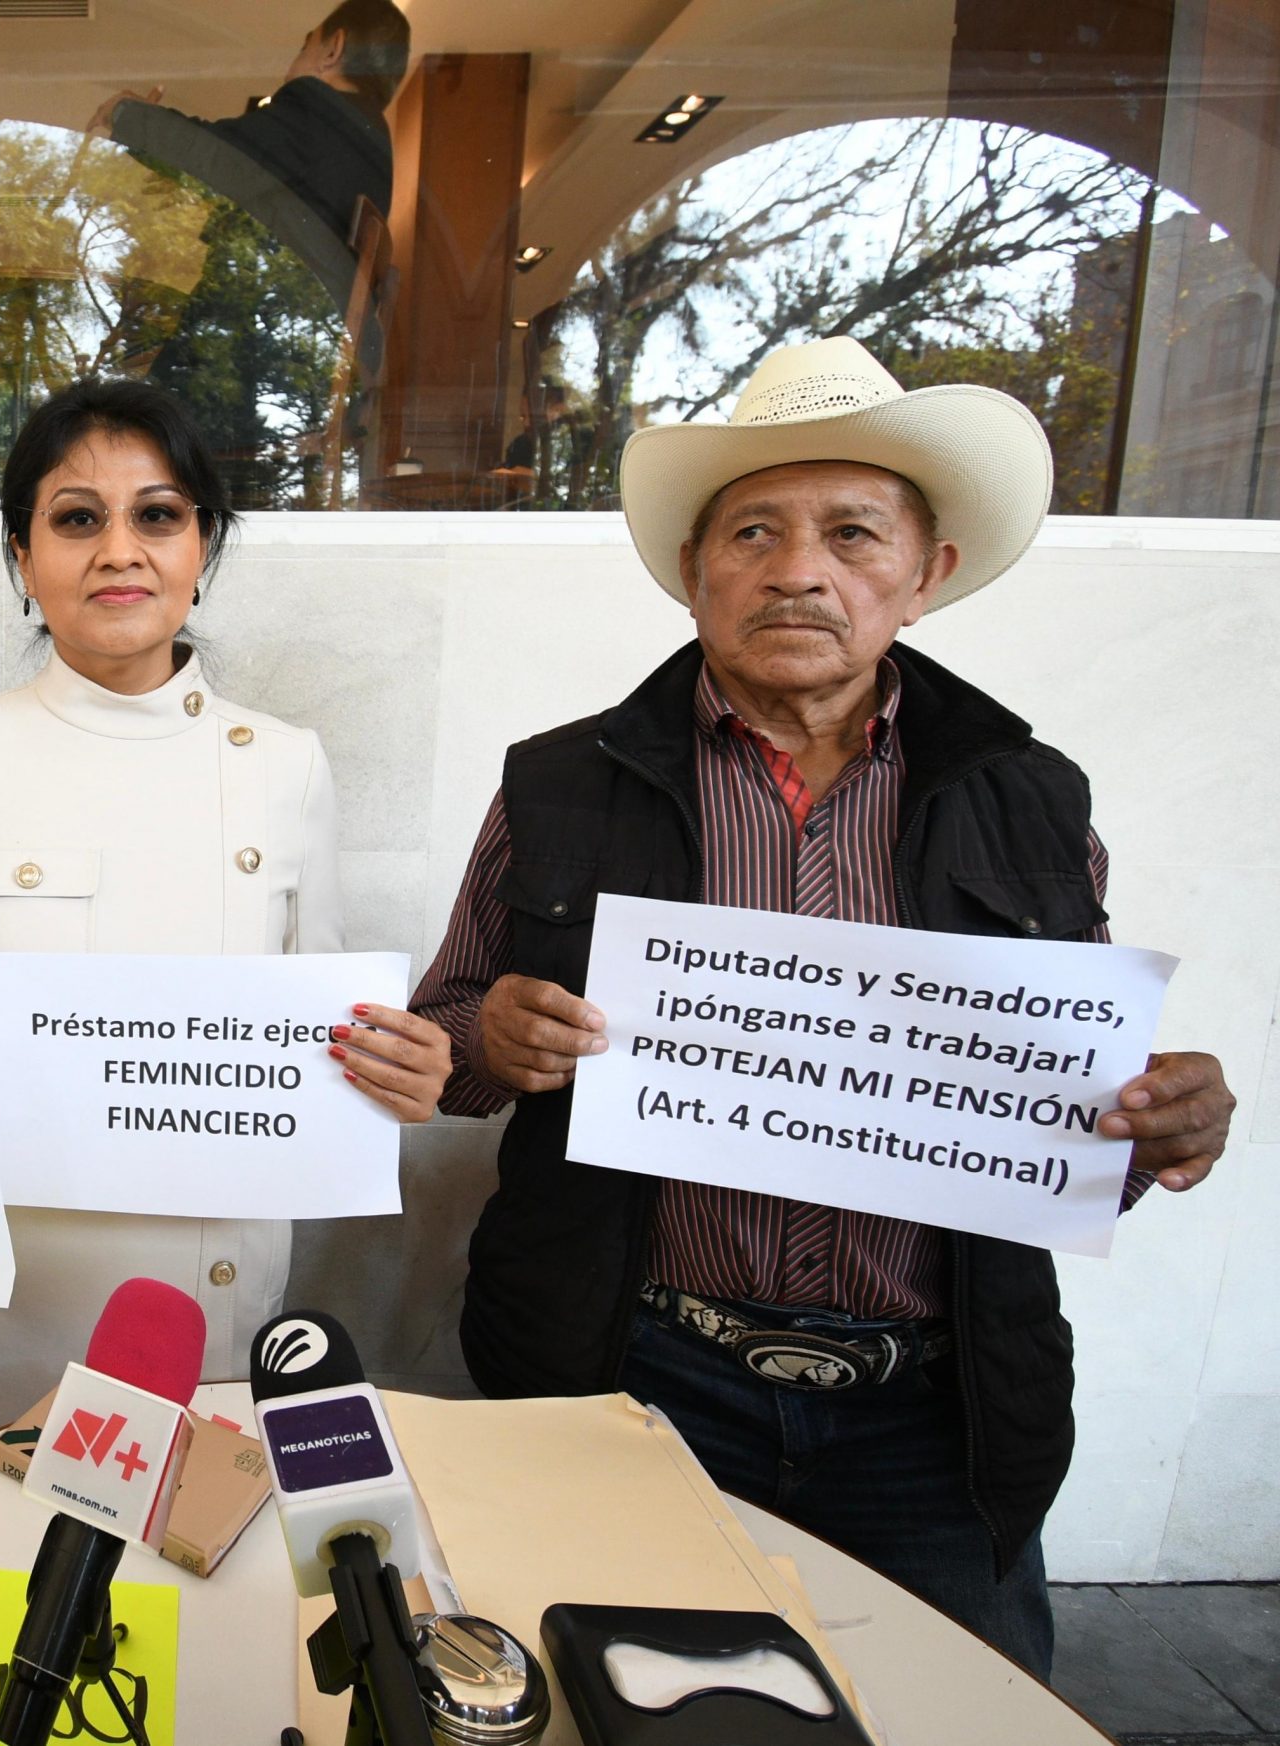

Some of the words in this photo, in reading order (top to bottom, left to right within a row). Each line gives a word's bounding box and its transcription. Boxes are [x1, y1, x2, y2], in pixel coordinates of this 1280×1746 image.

[645, 937, 844, 987] Diputados
[857, 971, 881, 997] y
[890, 971, 1126, 1030] Senadores,
[32, 1012, 176, 1040] Préstamo
[187, 1016, 254, 1041] Feliz
[263, 1018, 377, 1048] ejec
[655, 990, 857, 1034] ¡pónganse
[868, 1024, 891, 1045] a
[905, 1024, 1097, 1078] trabajar!
[104, 1060, 302, 1090] FEMINICIDIO
[630, 1035, 828, 1088] PROTEJAN
[839, 1066, 894, 1099] MI
[905, 1076, 1100, 1134] PENSIÓN
[108, 1106, 297, 1138] FINANCIERO
[637, 1085, 715, 1126] (Art.
[727, 1104, 750, 1131] 4
[761, 1108, 1071, 1196] Constitucional)
[280, 1431, 372, 1455] MEGANOTICIAS
[51, 1483, 118, 1518] nmas.com.mx
